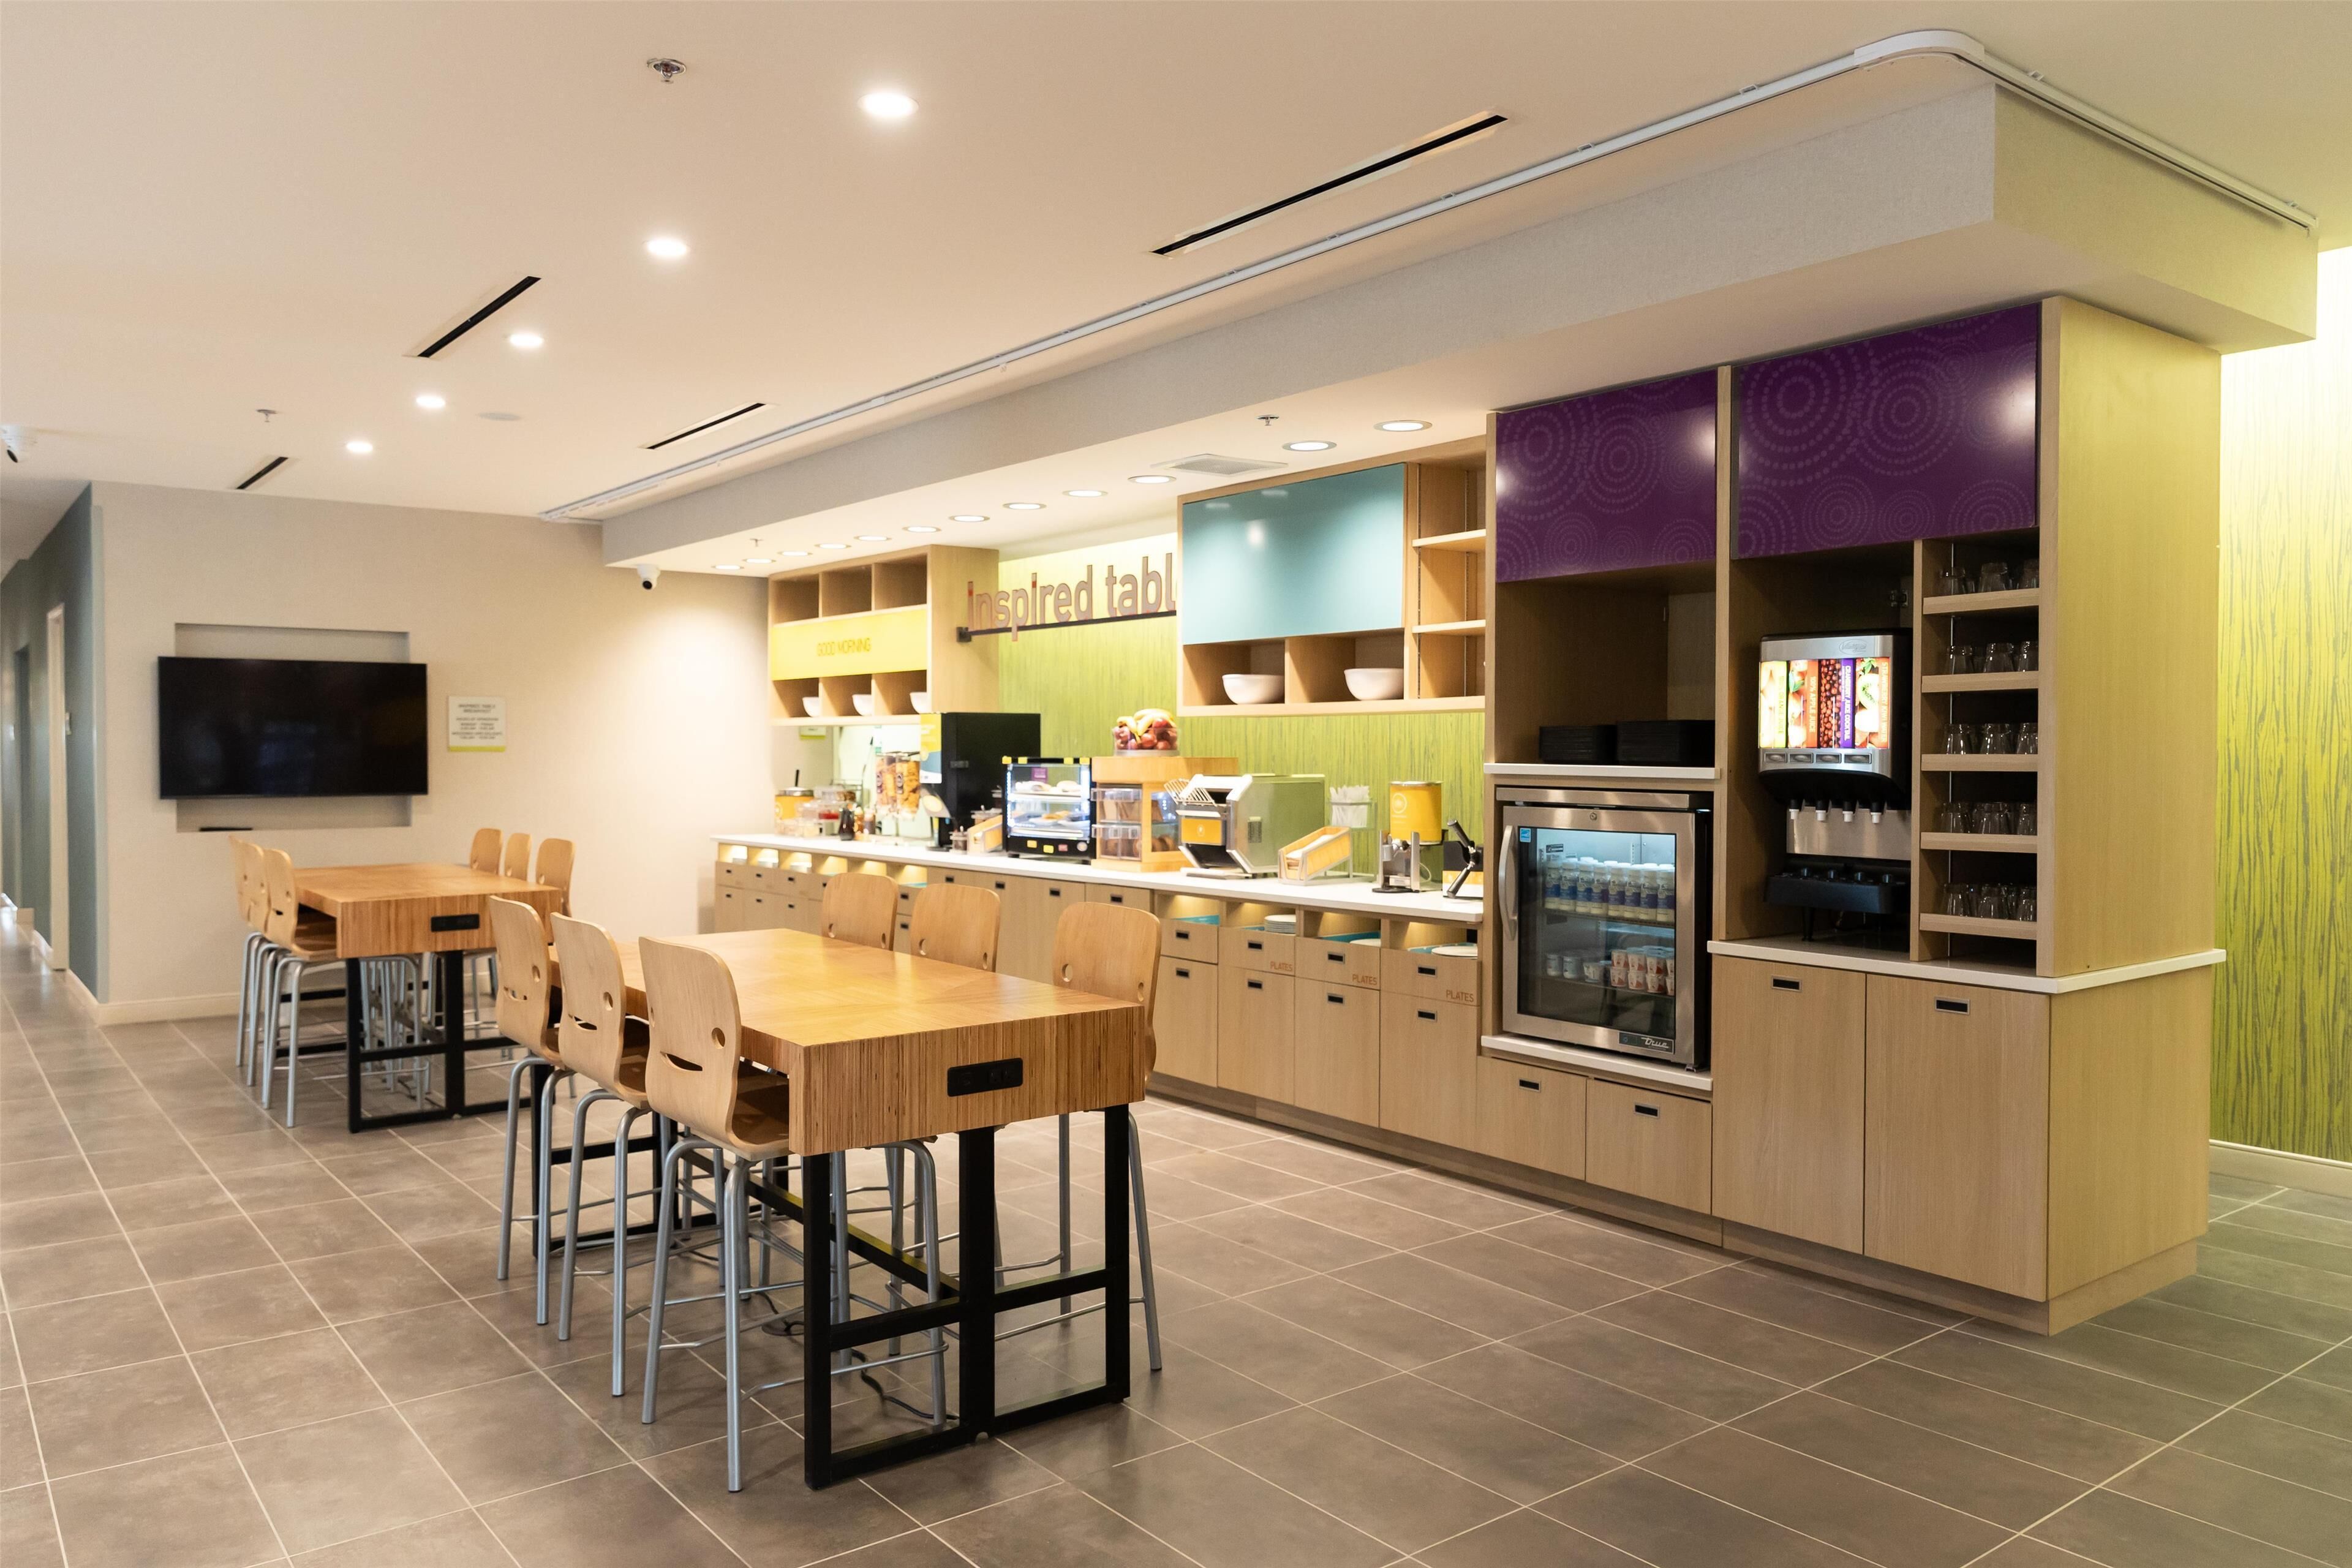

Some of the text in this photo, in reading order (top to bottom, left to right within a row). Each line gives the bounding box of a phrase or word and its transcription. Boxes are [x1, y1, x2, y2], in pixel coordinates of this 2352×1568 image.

[968, 552, 1177, 642] inspired tabl
[816, 638, 871, 657] GOOD MORNING
[1270, 960, 1294, 972] PLATES
[1352, 974, 1378, 986] PLATES
[1446, 989, 1474, 1003] PLATES
